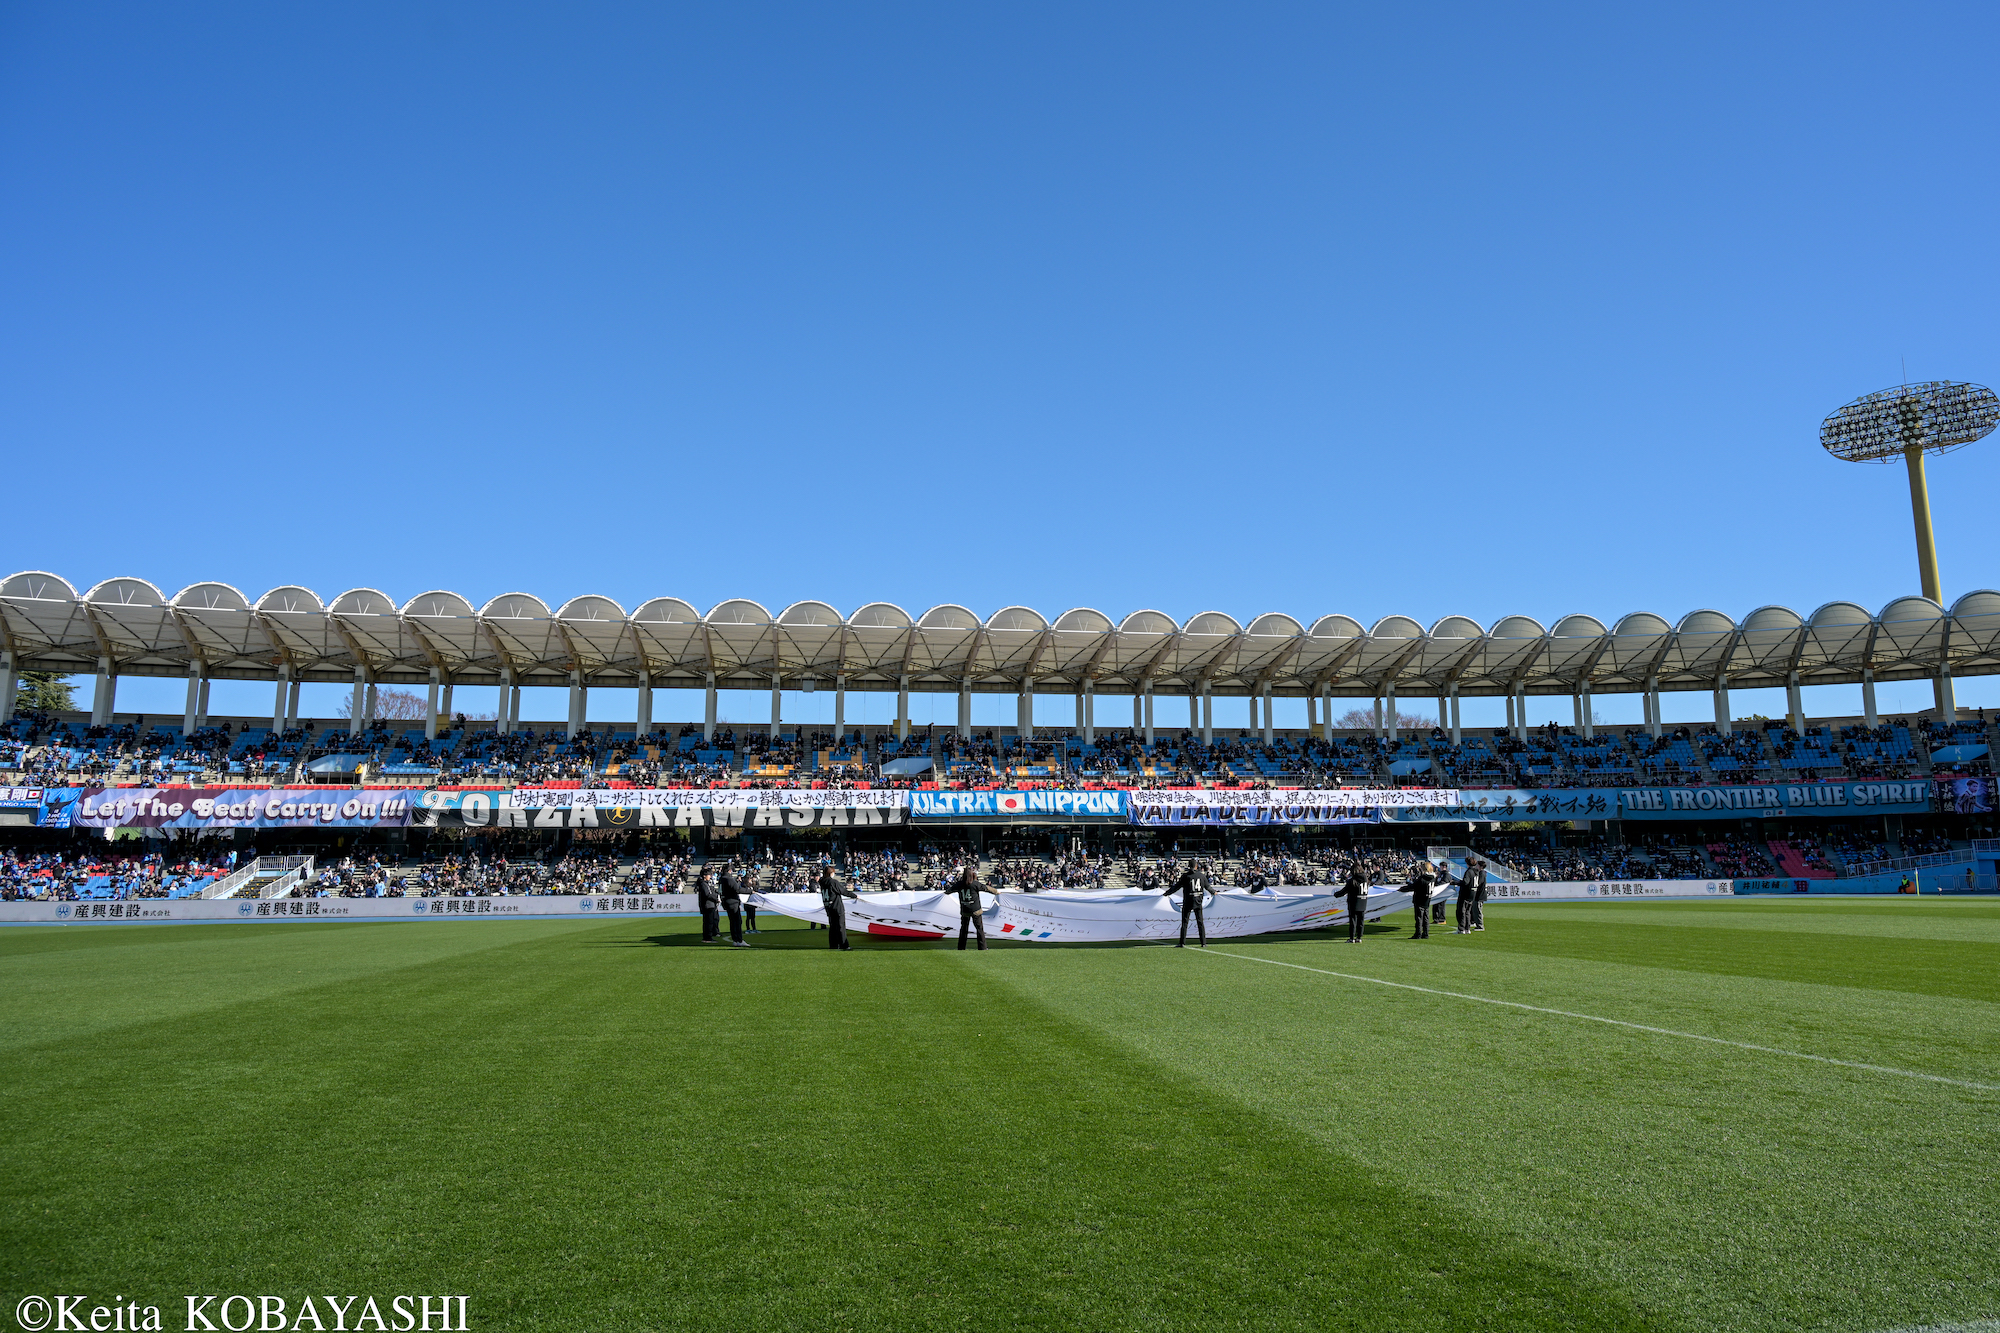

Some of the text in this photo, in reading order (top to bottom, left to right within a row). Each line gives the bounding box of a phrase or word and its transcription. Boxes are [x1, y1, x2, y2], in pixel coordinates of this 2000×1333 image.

[1028, 791, 1121, 814] NIPPON
[1621, 789, 1667, 811] THE
[1671, 786, 1782, 811] FRONTIER
[1787, 784, 1849, 809] BLUE
[1852, 782, 1928, 806] SPIRIT
[82, 798, 407, 822] Let The Beat Carry On !!!
[1190, 878, 1202, 892] 14
[1360, 882, 1369, 895] 14
[1599, 883, 1664, 896] 産興建設 株式会社
[961, 888, 973, 901] 14
[73, 903, 171, 918] 産興建設 株式会社
[255, 901, 349, 916] 産興建設 株式会社
[430, 899, 519, 914] 産興建設 株式会社
[595, 897, 682, 911] 産興建設 株式会社
